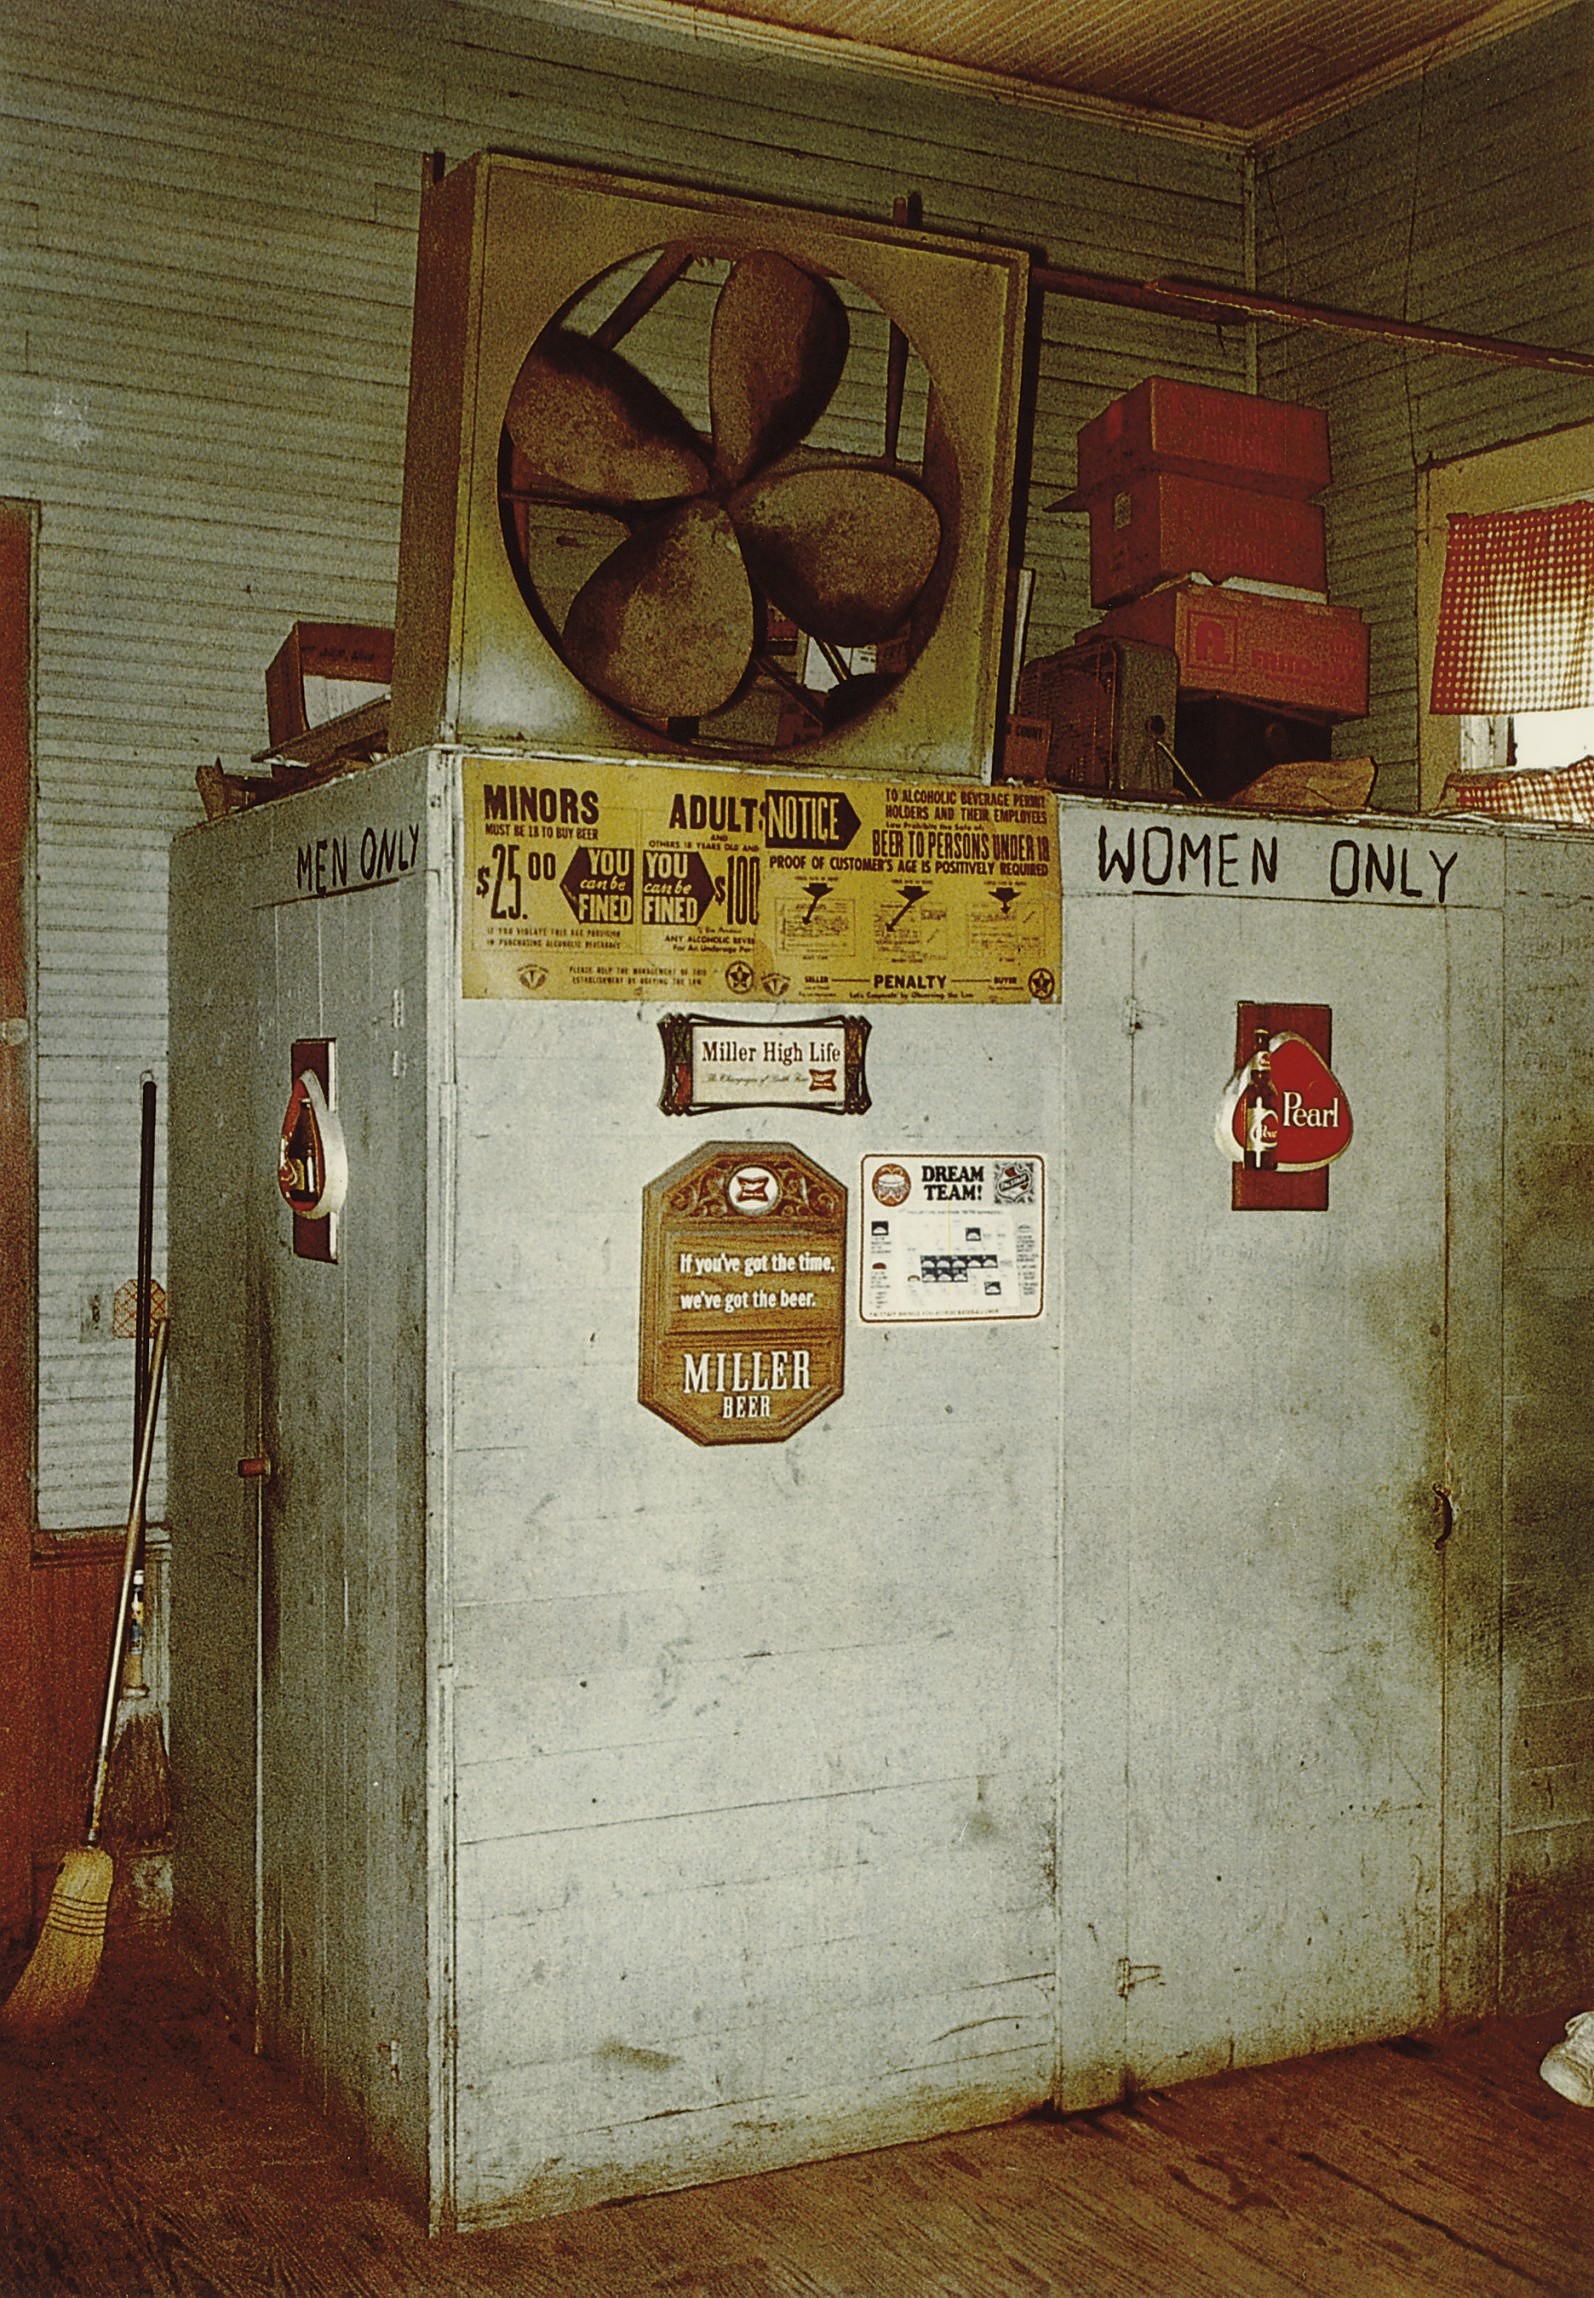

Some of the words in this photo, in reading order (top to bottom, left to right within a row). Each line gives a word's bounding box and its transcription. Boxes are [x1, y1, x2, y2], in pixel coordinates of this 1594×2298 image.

[484, 784, 599, 824] MINORS
[885, 788, 898, 802] TO
[902, 789, 956, 805] ALCOHOLIC
[961, 791, 1009, 807] BEVERAGE
[1013, 793, 1045, 808] PERMIT
[768, 795, 840, 840] NOTICE
[885, 805, 929, 820] HOLDERS
[934, 807, 954, 820] AND
[960, 808, 989, 822] THEIR
[994, 809, 1047, 824] EMPLOYEES
[485, 823, 510, 836] MUST
[514, 824, 525, 837] BE
[528, 826, 539, 838] 18
[542, 826, 553, 838] TO
[556, 827, 574, 839] BUY
[576, 827, 598, 840] BEER
[710, 834, 728, 842] AND
[649, 840, 680, 848] OTHERS
[696, 842, 721, 850] YEARS
[724, 843, 739, 851] OLD
[872, 829, 904, 857] BEER
[908, 830, 925, 858] TO
[928, 832, 990, 860] PERSONS
[993, 834, 1034, 861] UNDER
[297, 836, 347, 896] MEN
[360, 823, 419, 881] ONLY
[587, 849, 630, 876] YOU
[645, 852, 688, 879] YOU
[769, 855, 806, 869] PROOF
[811, 856, 825, 870] OF
[830, 857, 893, 872] CUSTOMER'S
[898, 860, 917, 873] AGE
[921, 861, 930, 873] IS
[935, 861, 995, 875] POSITIVELY
[1000, 862, 1048, 876] REQUIRED
[1098, 825, 1278, 888] WOMEN
[1330, 839, 1458, 903] ONLY
[579, 879, 607, 890] can
[610, 876, 626, 891] be
[643, 883, 672, 894] can
[674, 879, 692, 895] be
[578, 894, 632, 922] FINED
[643, 896, 698, 923] FINED
[688, 936, 730, 944] ALCOHOLIC
[701, 945, 736, 954] Underage
[873, 974, 947, 989] PENALTY
[993, 976, 1017, 984] BUYER
[702, 1041, 757, 1062] Miller
[763, 1041, 803, 1066] High
[809, 1042, 841, 1062] Life
[1283, 1091, 1339, 1128] Pearl
[921, 1165, 985, 1182] DREAM
[923, 1184, 982, 1201] TEAM!
[680, 1253, 693, 1273] If
[695, 1253, 740, 1276] you've
[744, 1254, 768, 1277] got
[771, 1252, 796, 1273] the
[798, 1251, 836, 1273] time,
[680, 1290, 722, 1310] we've
[724, 1292, 749, 1313] got
[752, 1289, 777, 1308] the
[779, 1288, 816, 1308] beer.
[682, 1350, 811, 1394] MILLER
[722, 1395, 771, 1419] BEER
